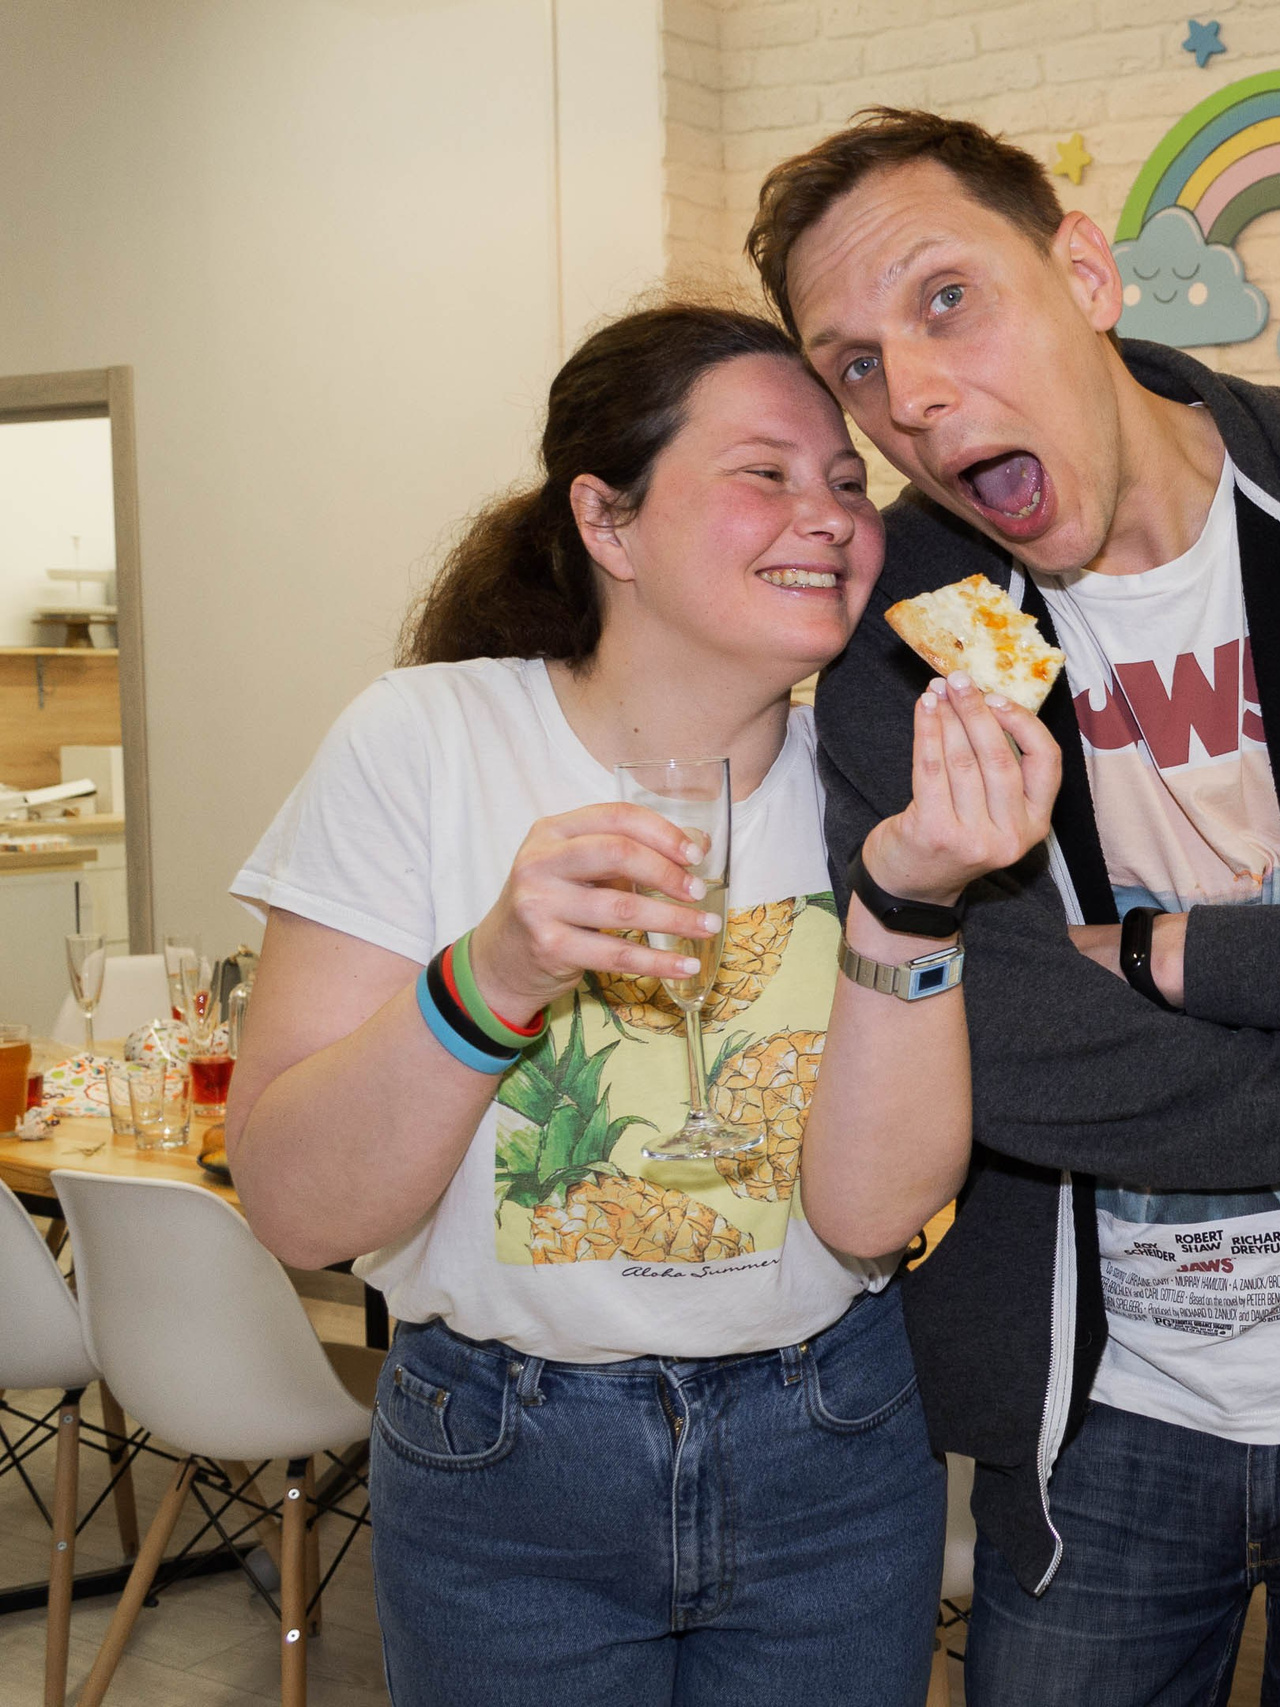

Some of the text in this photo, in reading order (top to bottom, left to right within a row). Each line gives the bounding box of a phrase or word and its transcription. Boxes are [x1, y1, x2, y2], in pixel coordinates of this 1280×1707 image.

[1175, 1230, 1223, 1244] ROBERT
[1133, 1241, 1158, 1250] ROY
[1182, 1243, 1221, 1253] SHAW
[1124, 1249, 1176, 1262] SCHEIDER
[622, 1258, 781, 1278] Aloha Summer
[1174, 1276, 1201, 1289] MURRAY
[1200, 1276, 1228, 1292] HAMILTON
[1238, 1295, 1246, 1308] by
[1246, 1293, 1266, 1307] PETER
[1180, 1307, 1206, 1319] RICHARD
[1214, 1308, 1238, 1321] ZANUCK
[1238, 1310, 1250, 1322] and
